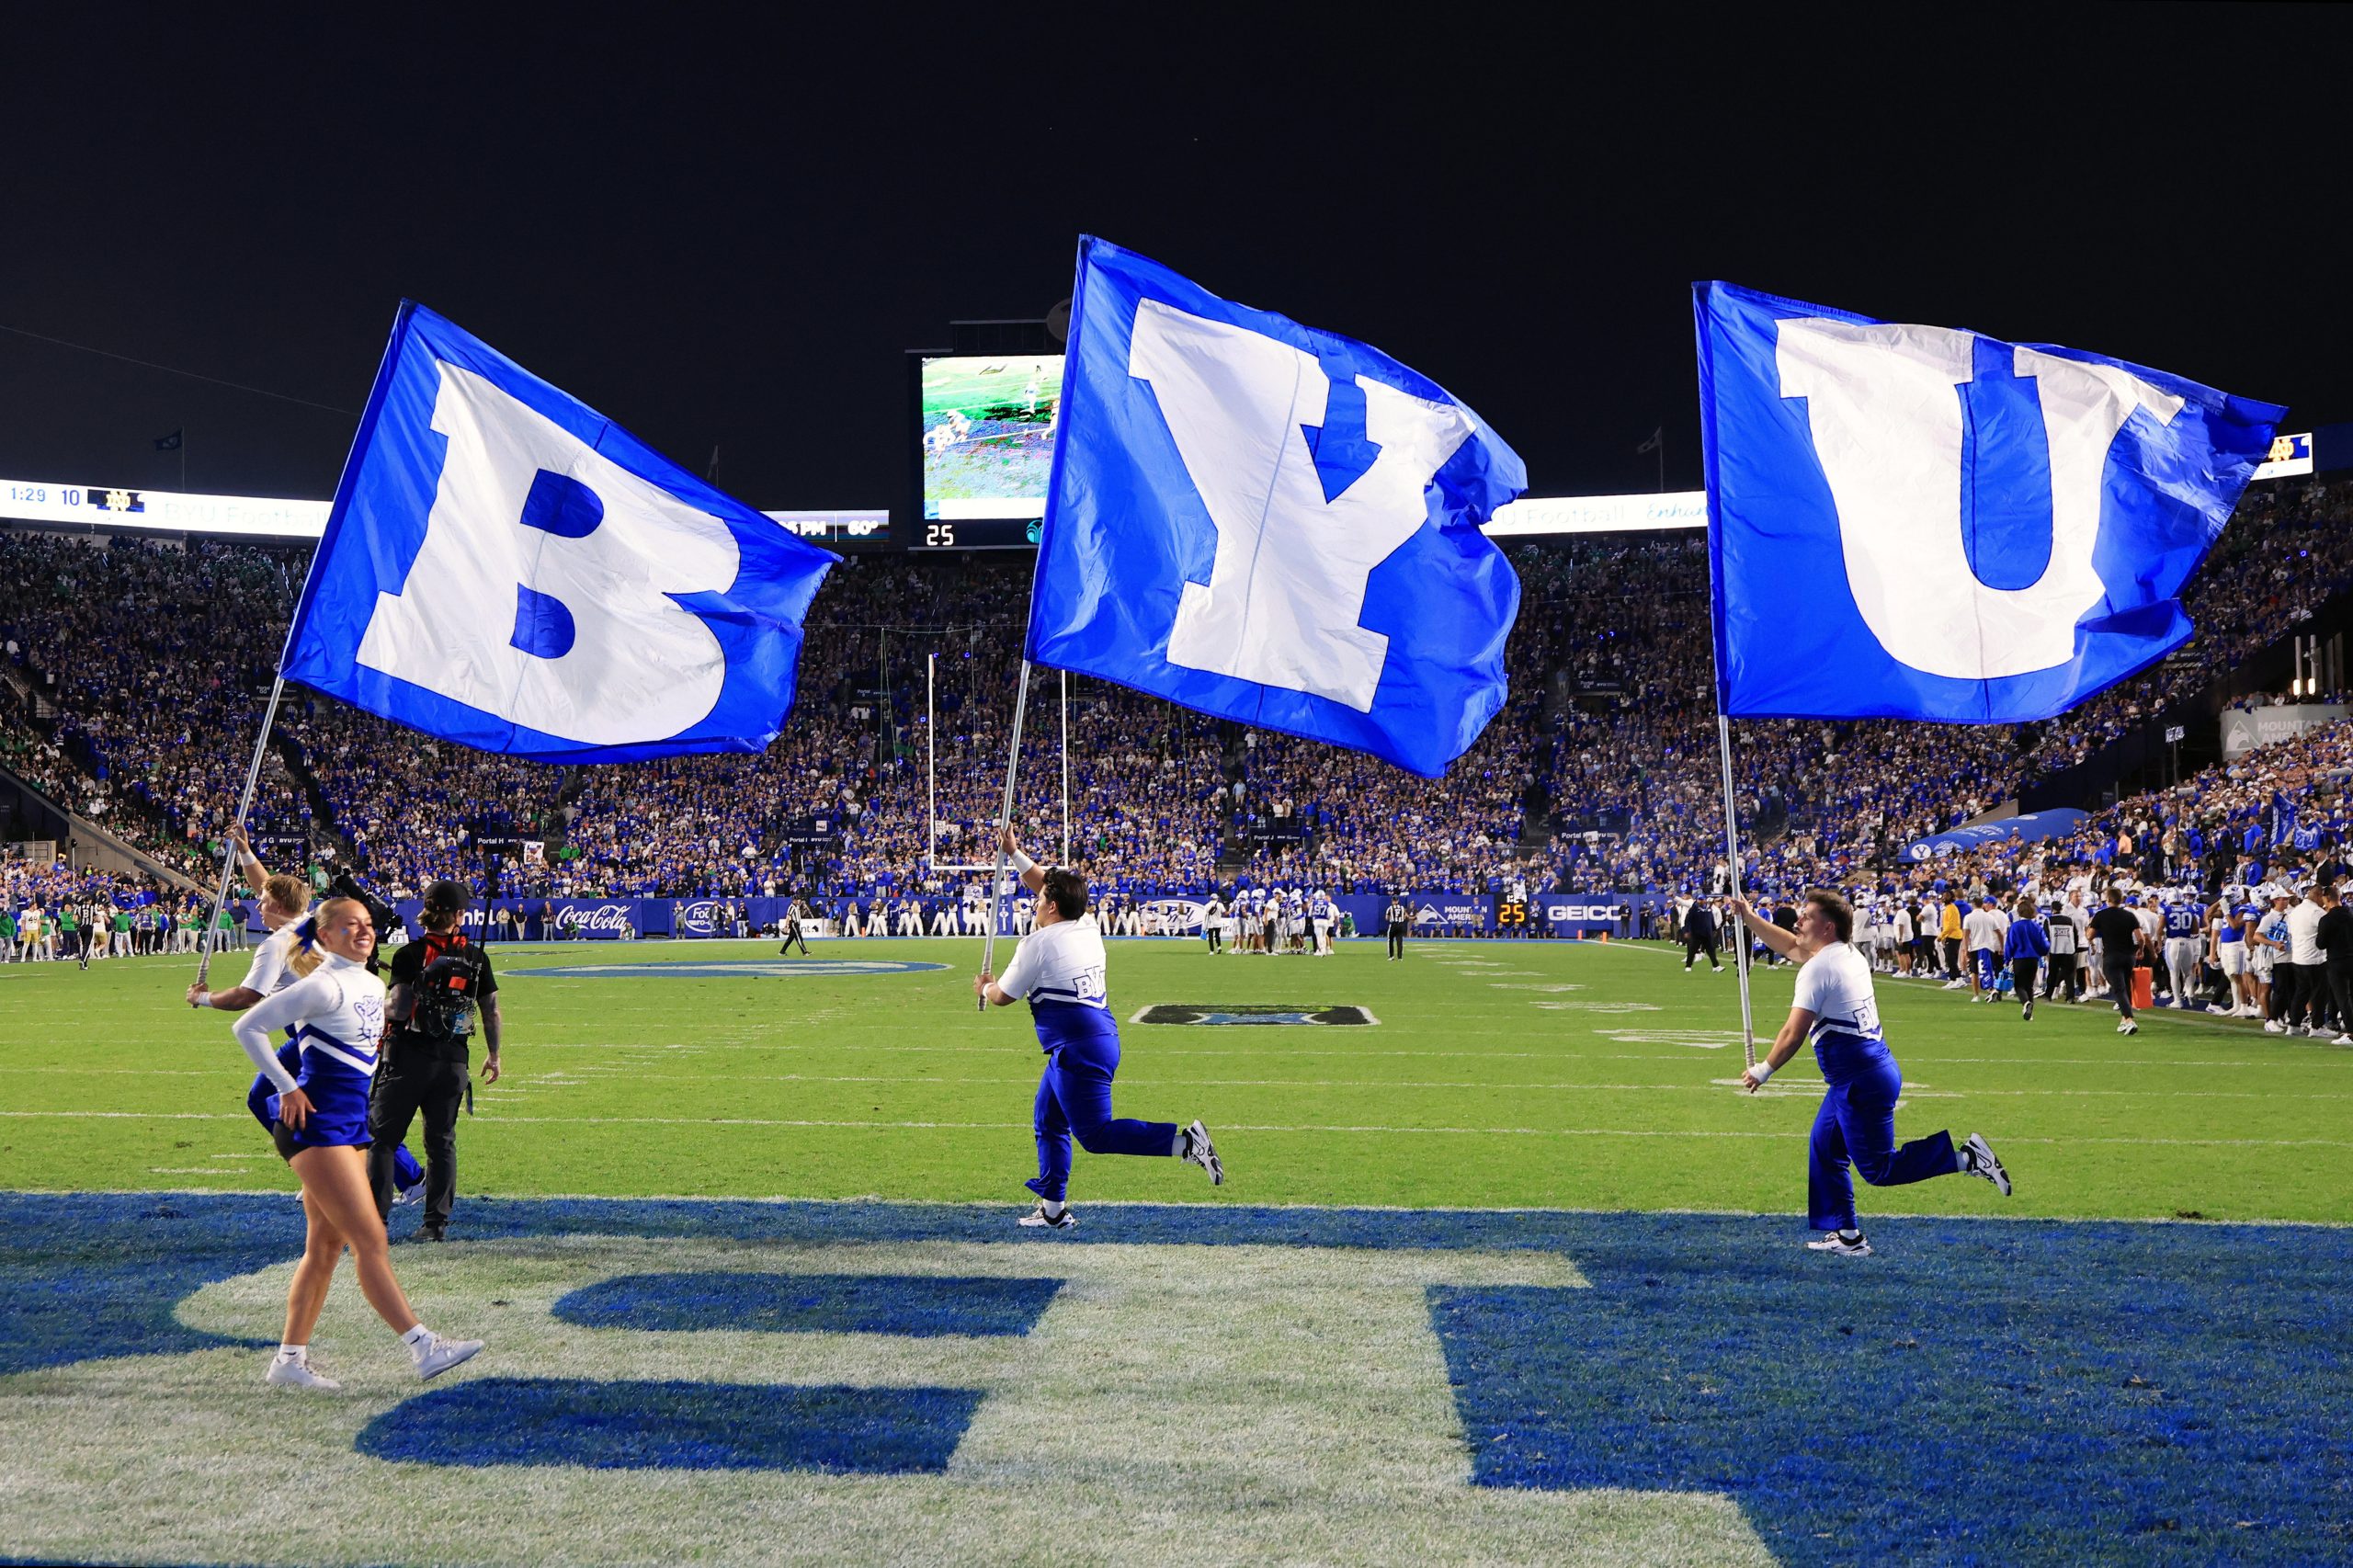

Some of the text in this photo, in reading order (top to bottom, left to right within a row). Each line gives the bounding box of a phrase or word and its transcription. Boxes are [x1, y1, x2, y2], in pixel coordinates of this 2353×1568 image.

[10, 487, 80, 506] 1:29 10
[1127, 296, 1478, 714] Y
[1774, 317, 2187, 680] U
[926, 525, 954, 546] 25
[356, 358, 741, 746] B
[554, 904, 631, 930] Coca-Cola
[1313, 905, 1327, 916] 97
[1444, 905, 1488, 914] MOUNTN
[1447, 913, 1485, 921] AMER
[1498, 903, 1526, 923] 25
[1548, 905, 1621, 921] GEICO
[2168, 912, 2193, 930] 30
